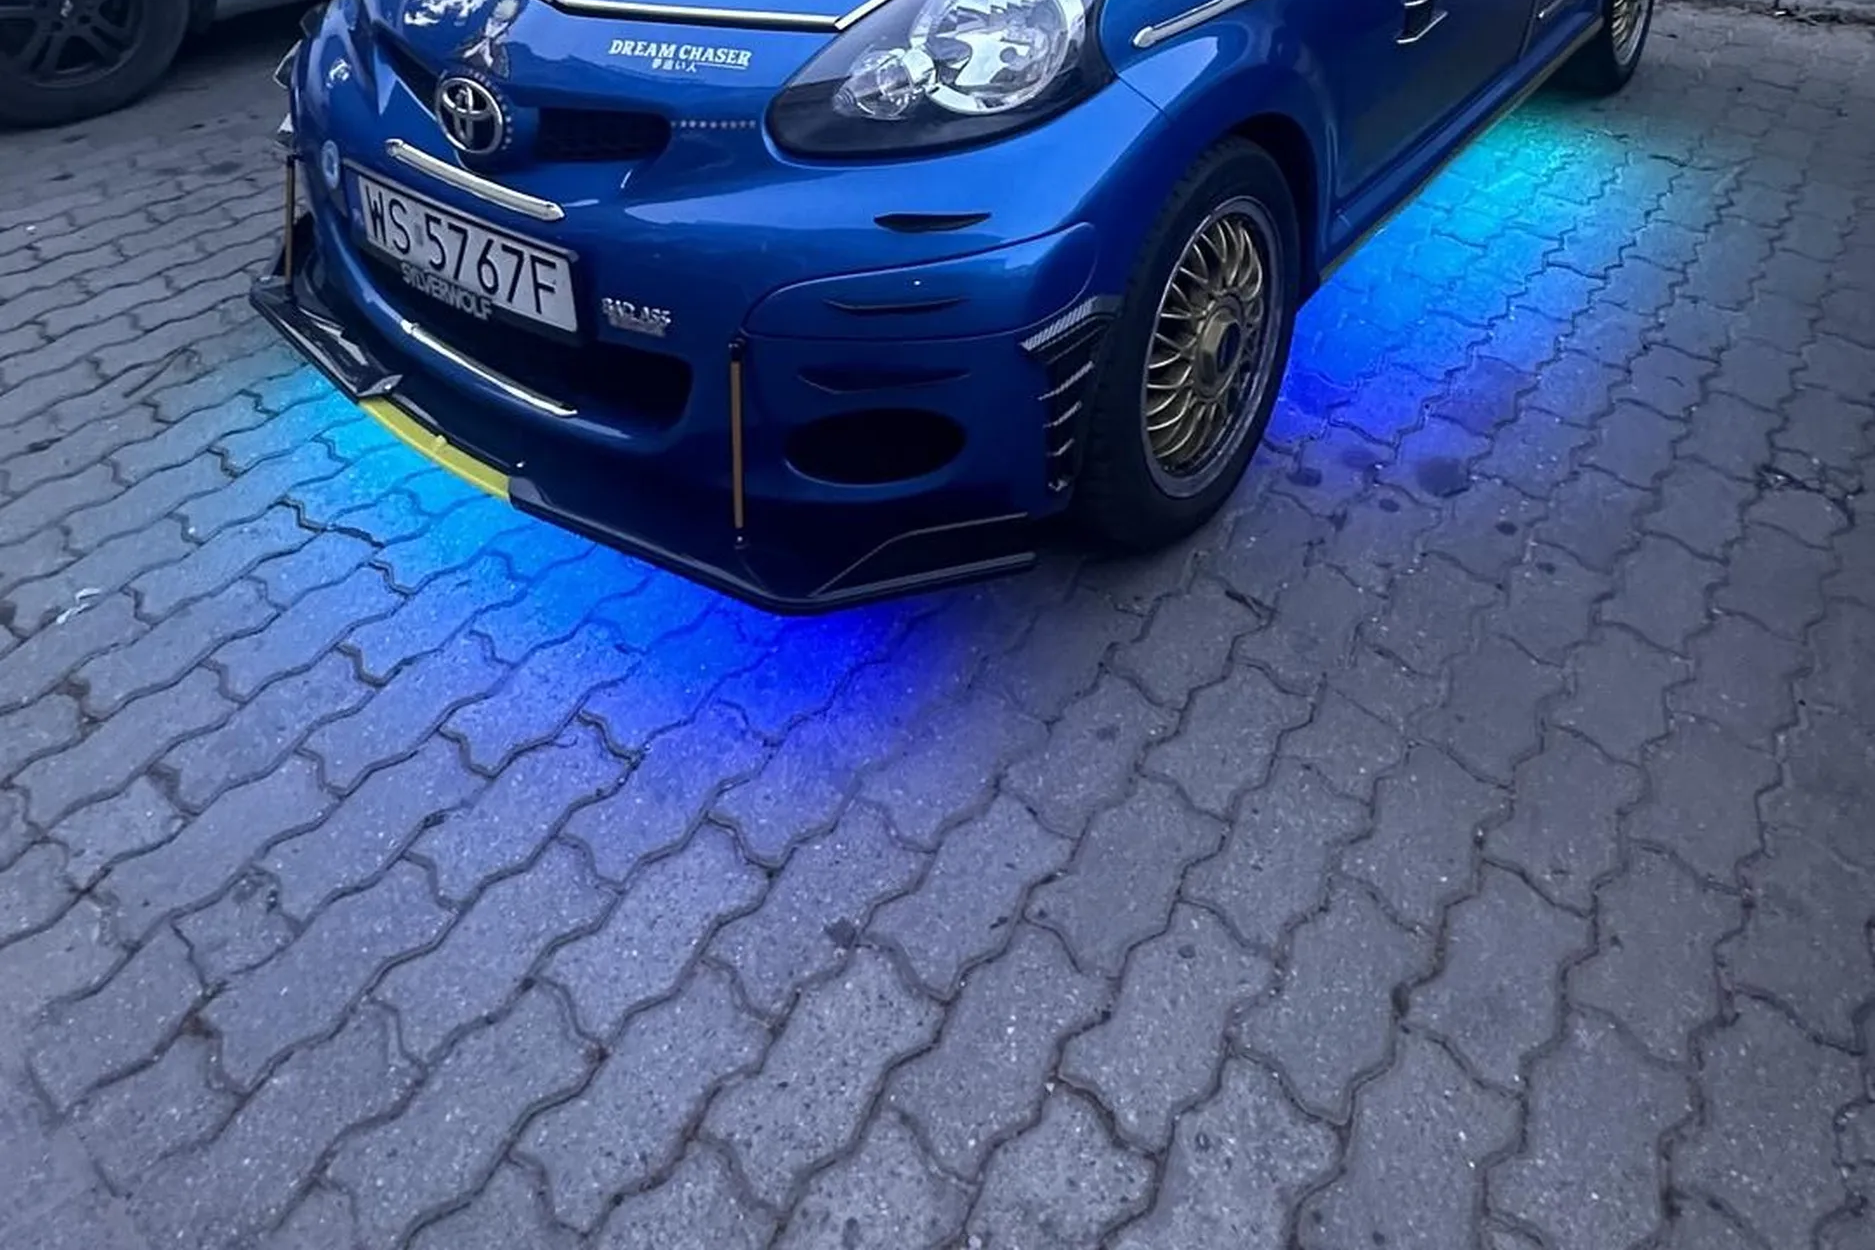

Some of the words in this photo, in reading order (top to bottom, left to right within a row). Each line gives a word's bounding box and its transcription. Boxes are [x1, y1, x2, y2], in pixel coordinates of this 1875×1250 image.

[609, 39, 677, 58] DREAM
[678, 44, 752, 67] CHASER
[365, 184, 411, 255] WS
[424, 213, 557, 315] 5767F
[400, 262, 493, 321] SILVERWOLF
